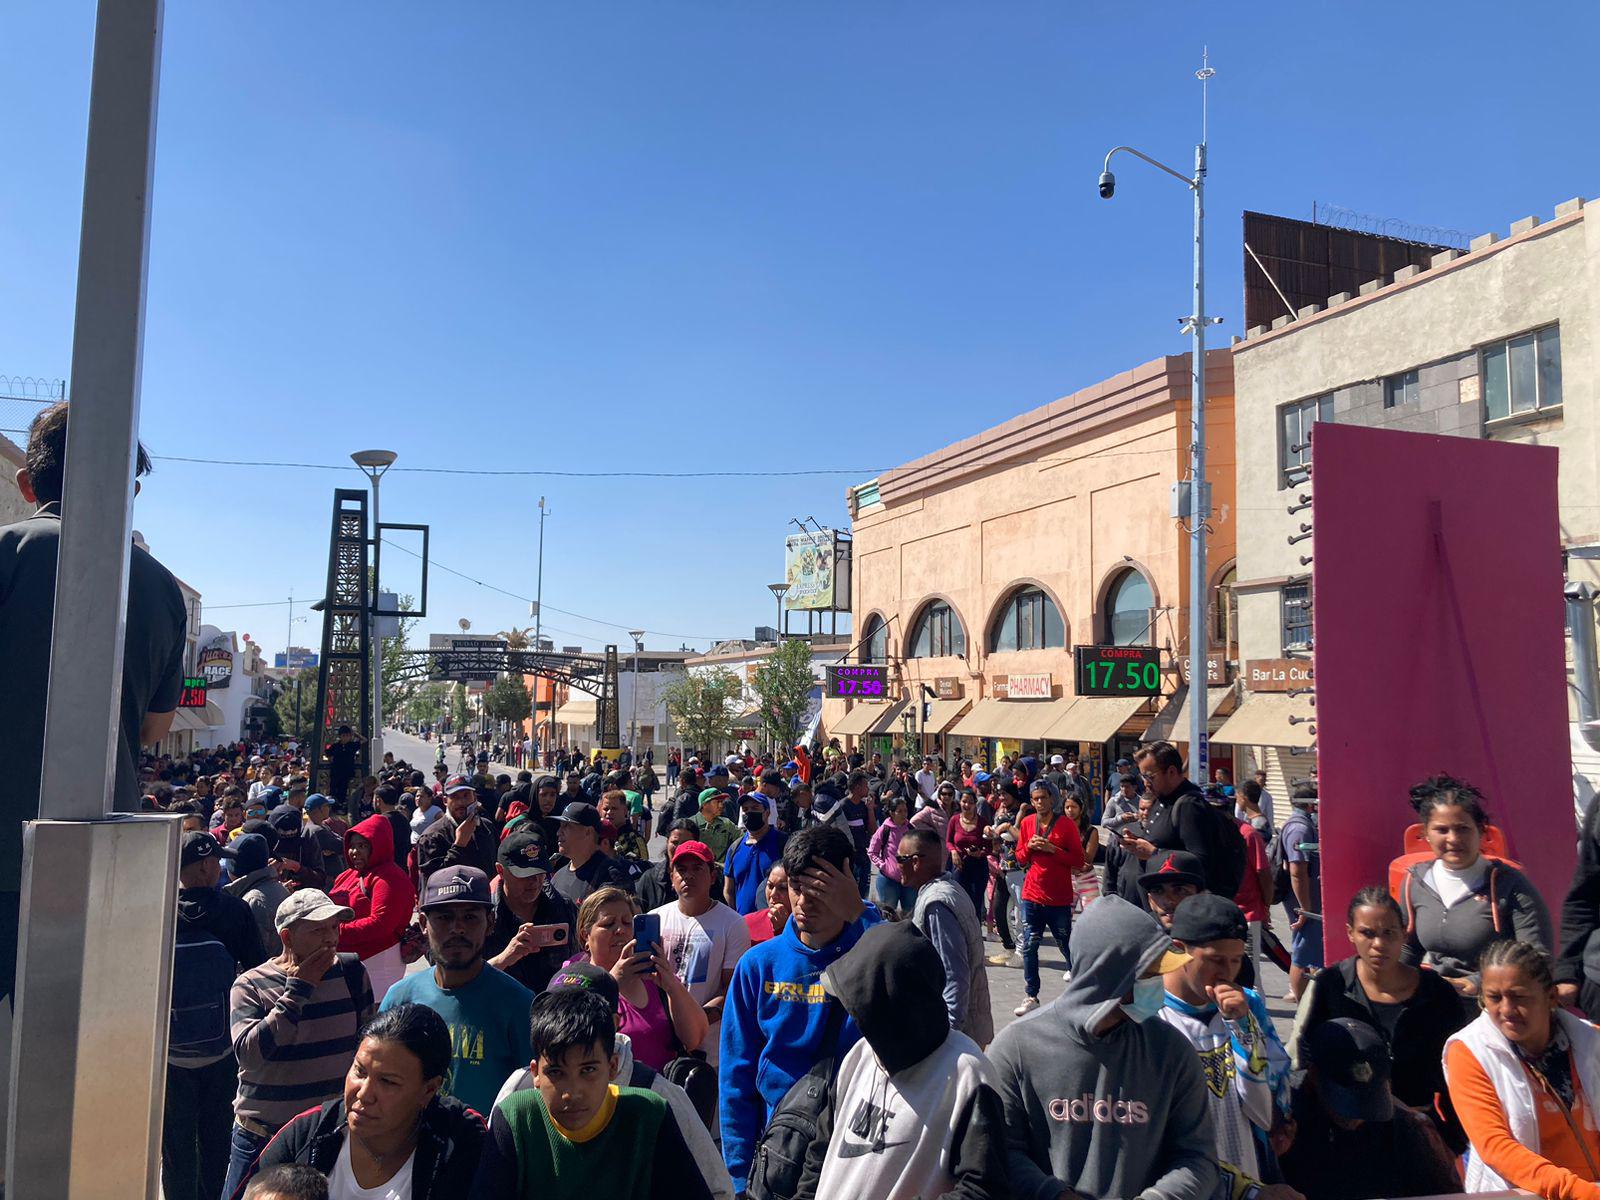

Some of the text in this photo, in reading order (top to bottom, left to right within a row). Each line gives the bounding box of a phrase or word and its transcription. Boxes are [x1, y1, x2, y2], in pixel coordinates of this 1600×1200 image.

[1101, 649, 1142, 659] COMPRA
[204, 666, 231, 676] RACE
[837, 668, 879, 677] COMPRA
[1086, 661, 1159, 690] 17.50
[1252, 668, 1270, 681] Bar
[1272, 668, 1285, 681] La
[184, 678, 206, 688] mpra
[837, 680, 883, 696] 17.50
[993, 682, 1008, 692] Farma
[1010, 677, 1050, 697] PHARMACY
[180, 689, 205, 705] 7.50
[437, 885, 467, 896] PUMA
[764, 981, 826, 996] BRUI
[1048, 1093, 1150, 1123] adidas
[848, 1098, 897, 1154] NIKE
